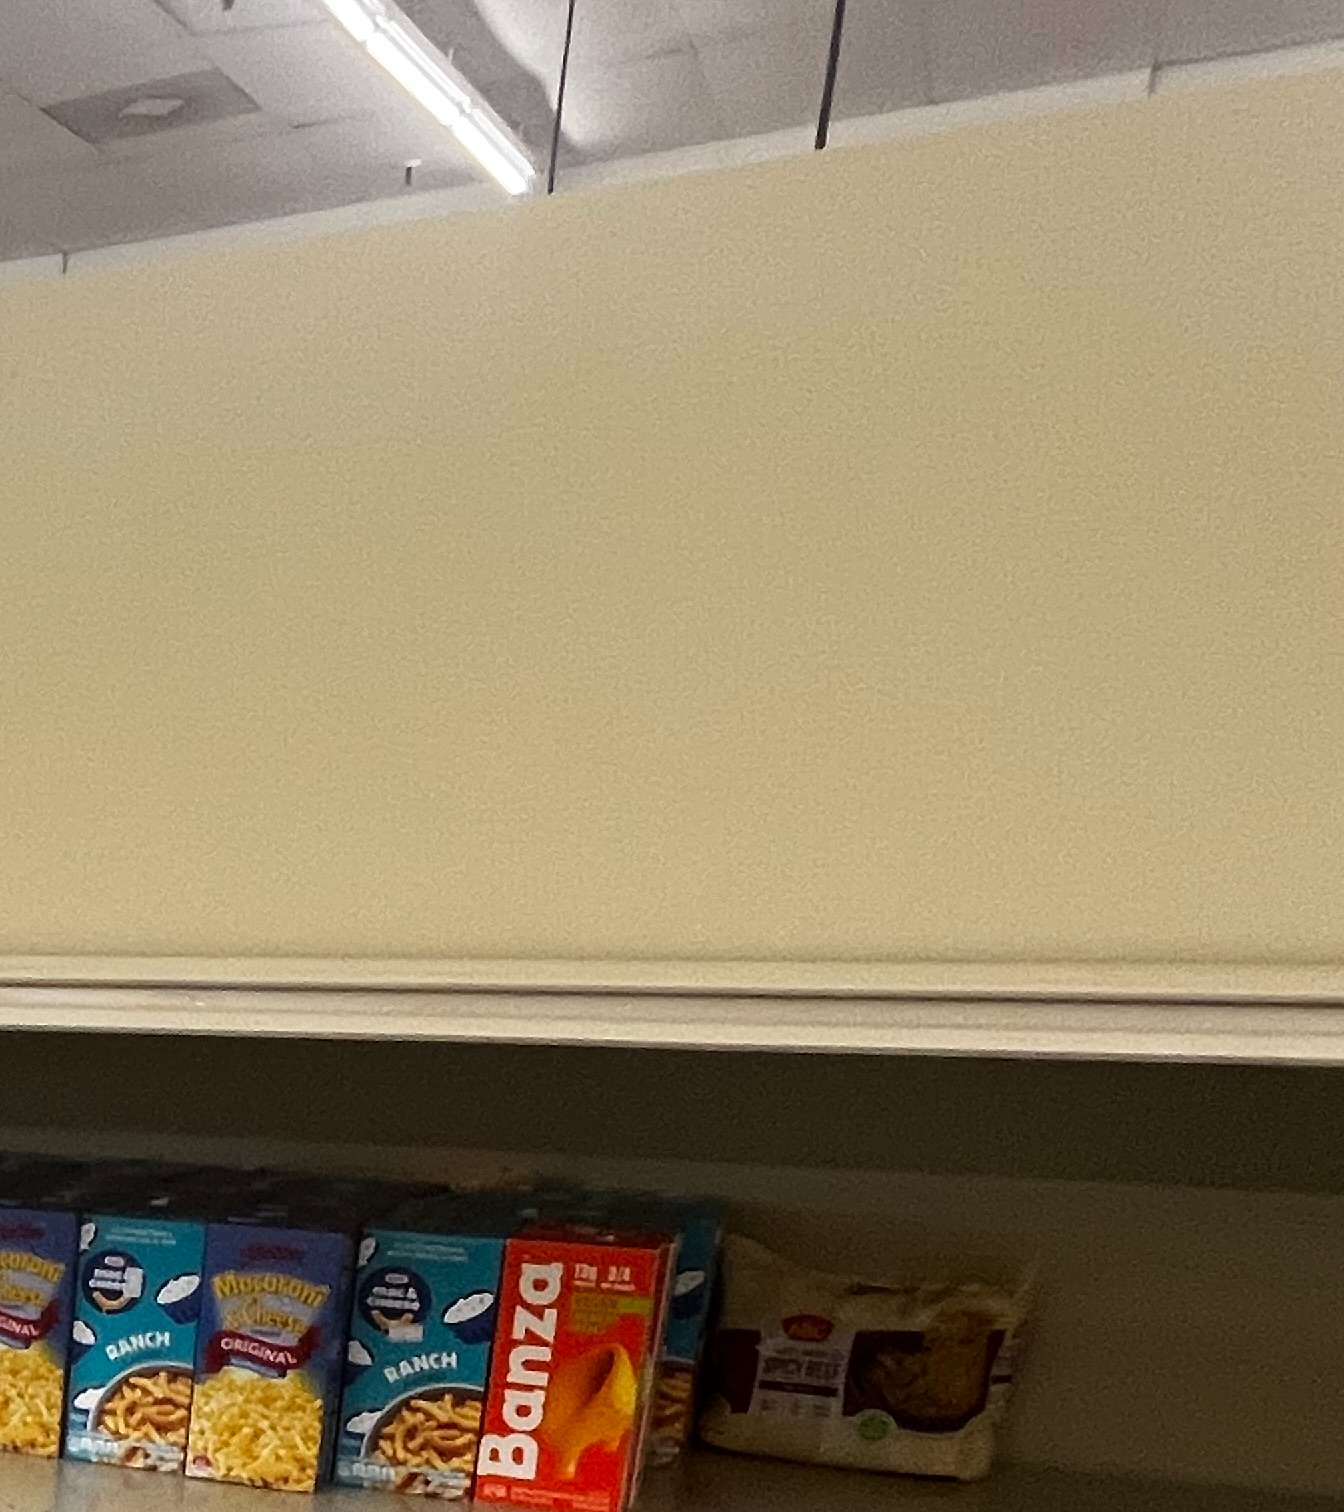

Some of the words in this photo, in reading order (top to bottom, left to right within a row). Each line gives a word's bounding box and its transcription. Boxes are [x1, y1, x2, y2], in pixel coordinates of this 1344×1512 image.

[212, 1270, 331, 1308] Macaroni
[105, 1331, 171, 1361] RANCH
[219, 1336, 298, 1365] ORIGINAL
[383, 1351, 458, 1384] RANCH
[476, 1262, 565, 1480] Banza
